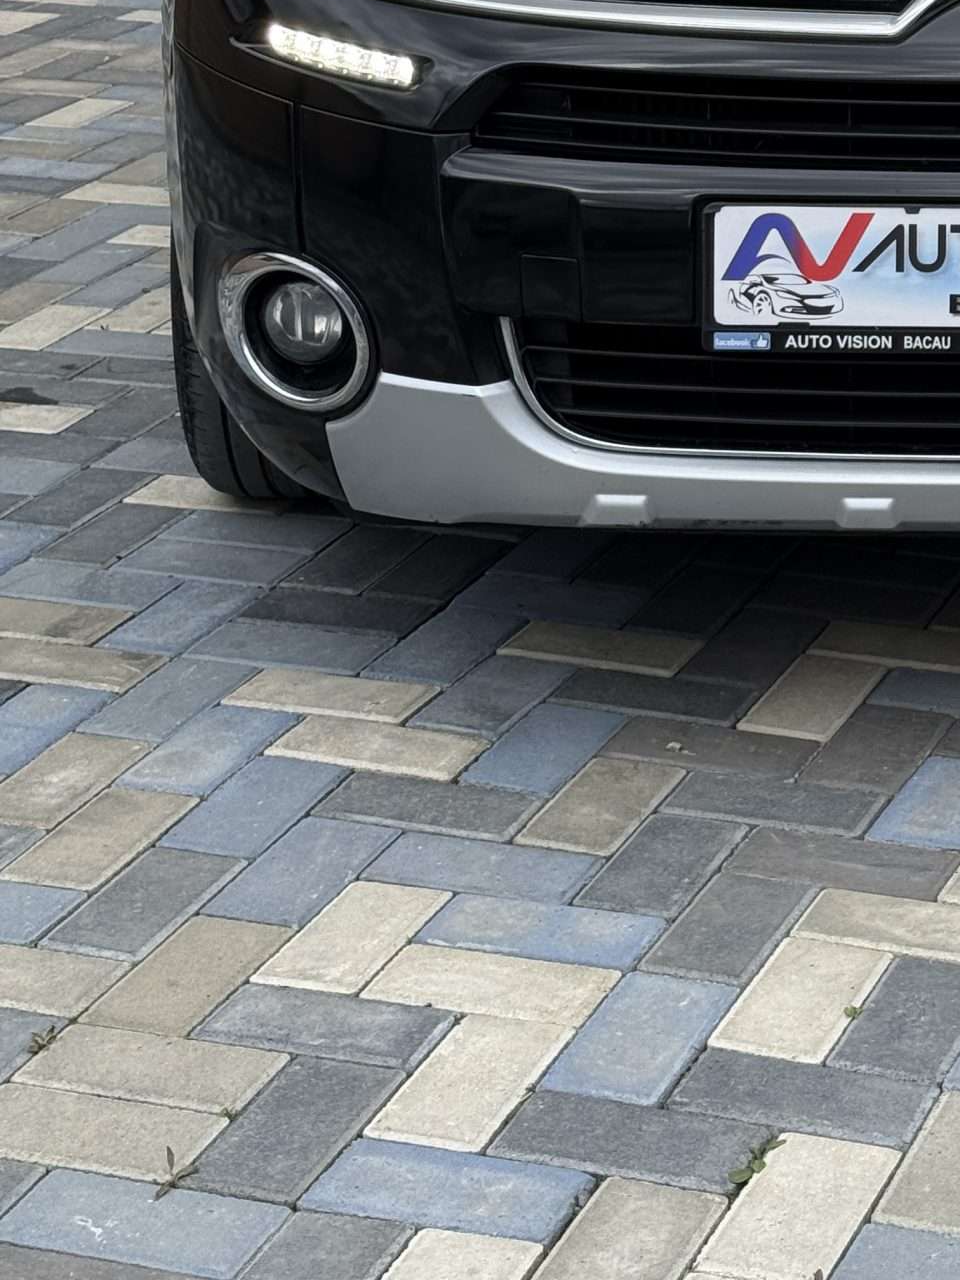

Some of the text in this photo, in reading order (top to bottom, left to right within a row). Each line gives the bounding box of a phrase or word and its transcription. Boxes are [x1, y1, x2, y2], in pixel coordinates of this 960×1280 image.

[784, 334, 951, 350] AUTO VISION BACAU
